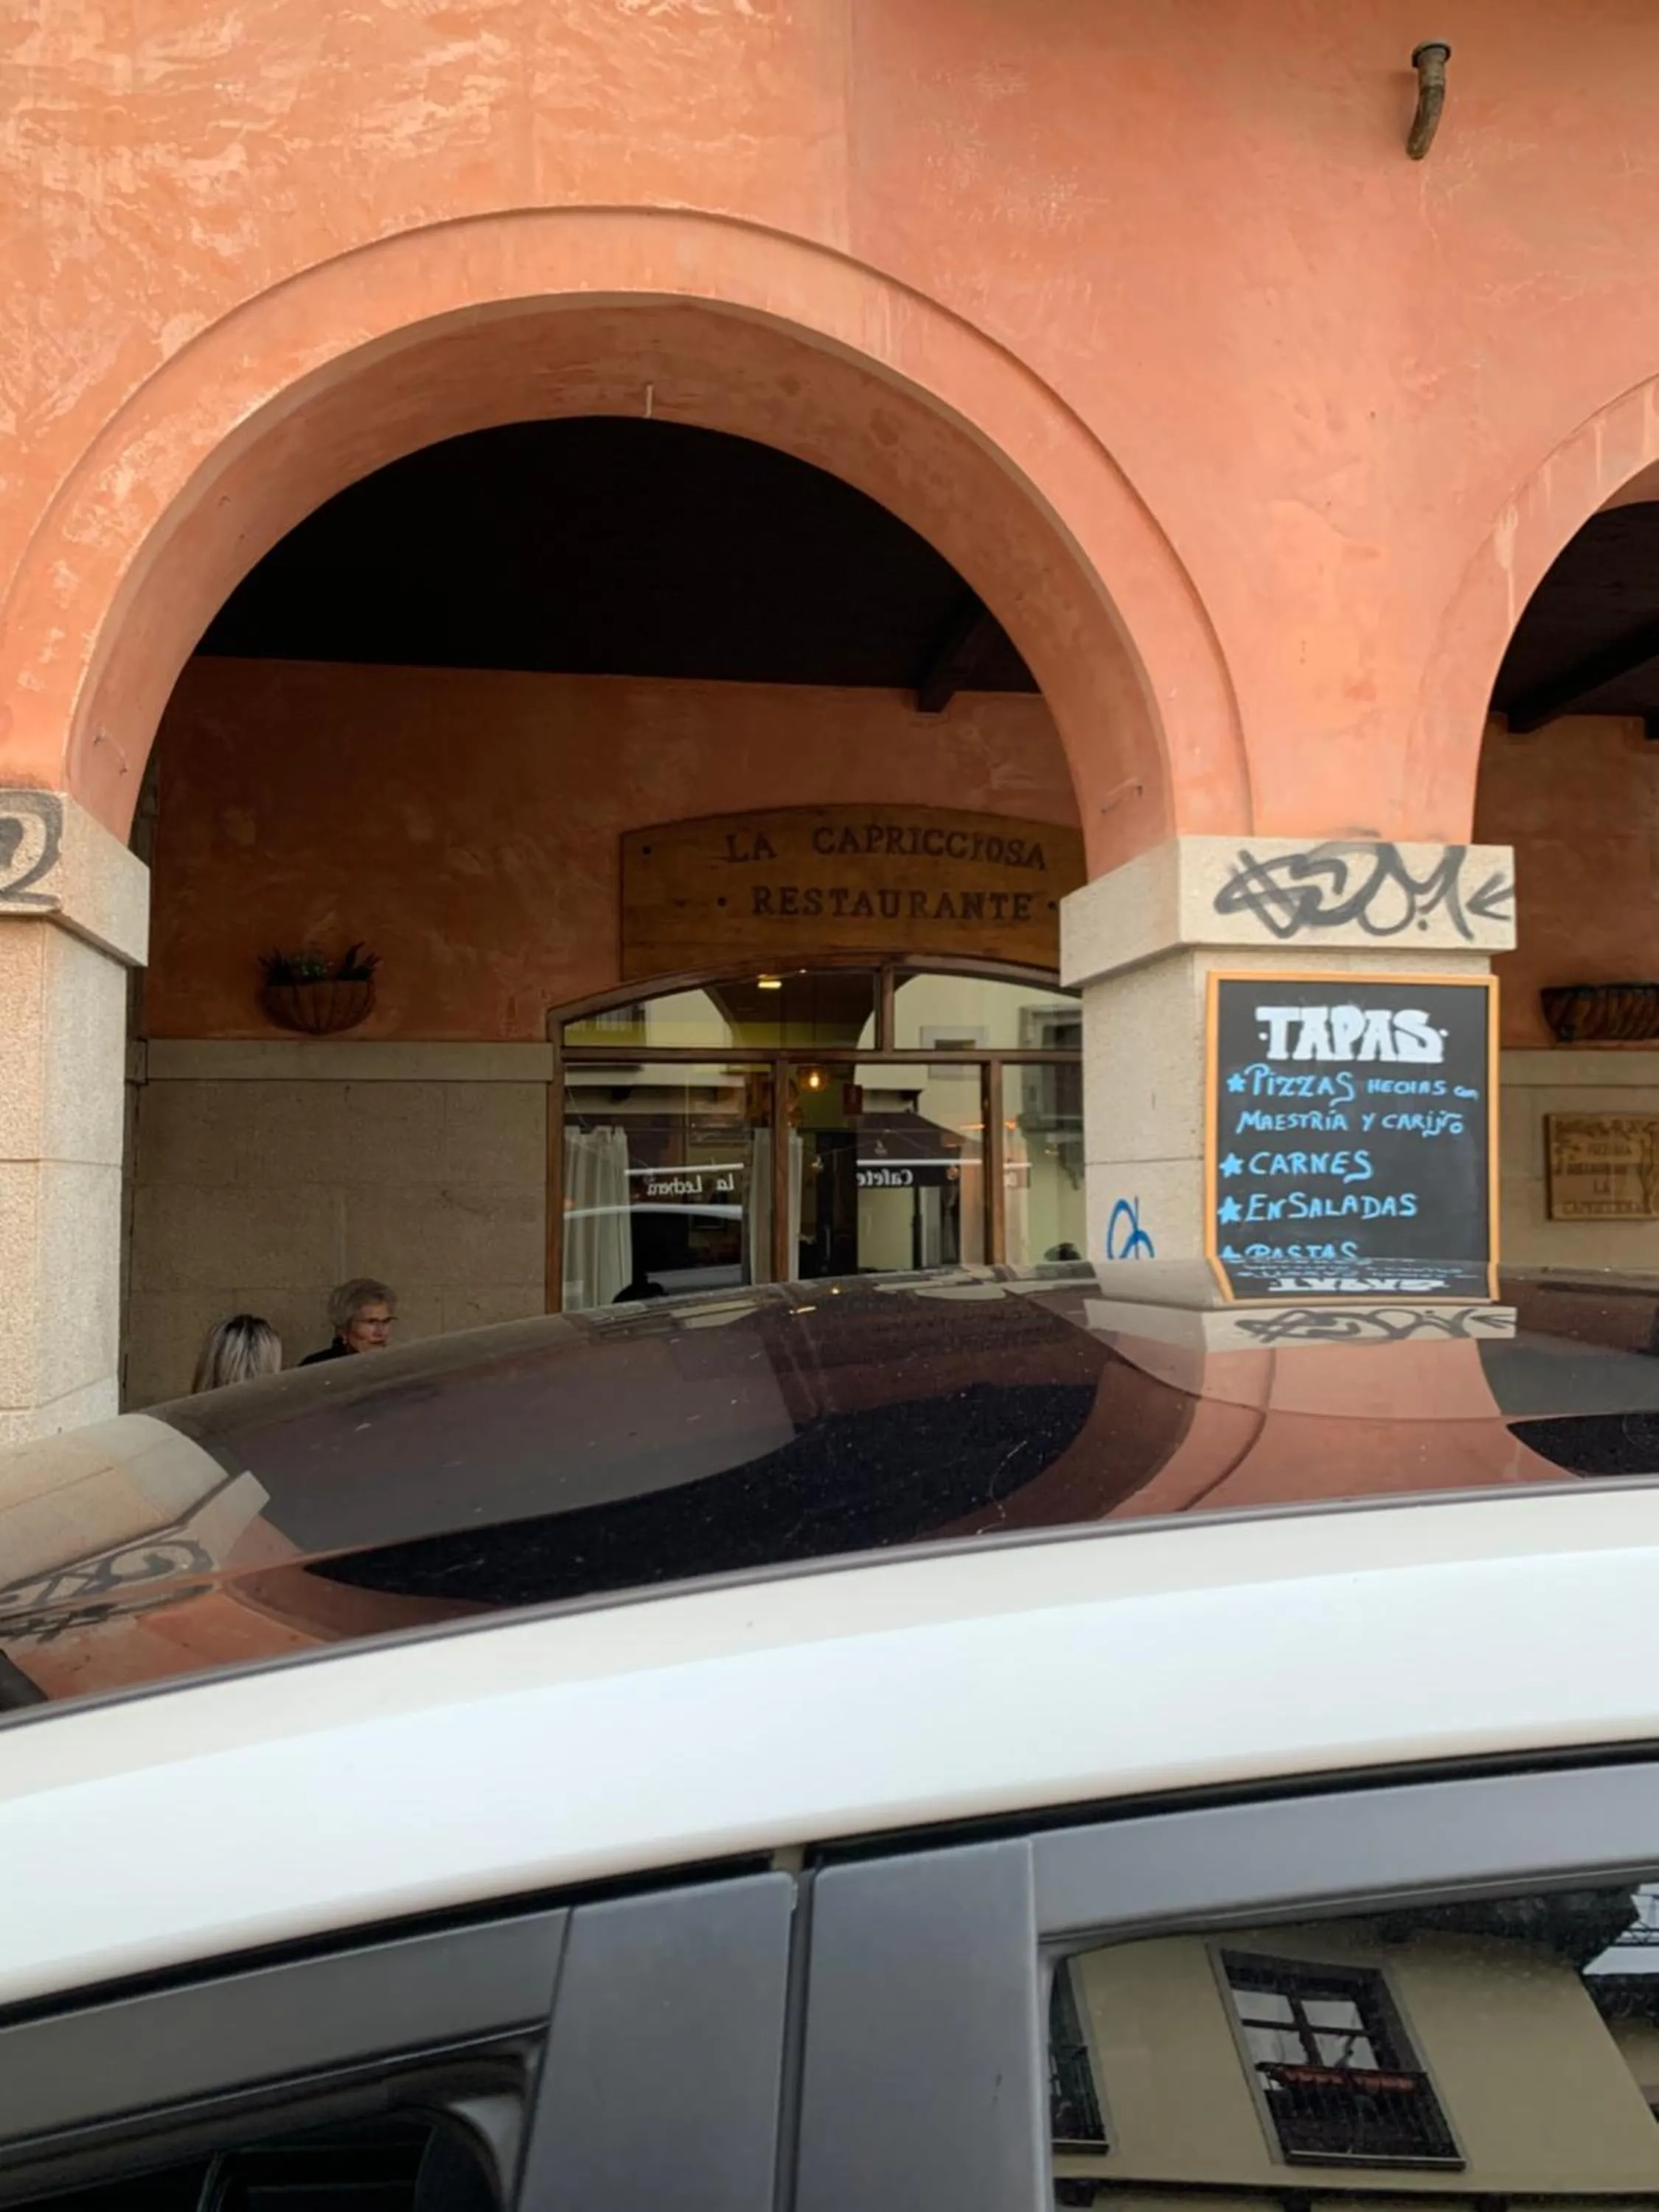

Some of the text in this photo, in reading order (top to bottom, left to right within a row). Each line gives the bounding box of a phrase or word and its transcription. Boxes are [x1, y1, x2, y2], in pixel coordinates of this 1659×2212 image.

[724, 825, 1046, 870] LA CAPRICCIOSA
[751, 886, 1033, 922] RESTAURANTE
[1255, 1004, 1444, 1063] TAPAS
[1367, 1078, 1447, 1096] HECHAS
[1248, 1149, 1374, 1184] CARNES
